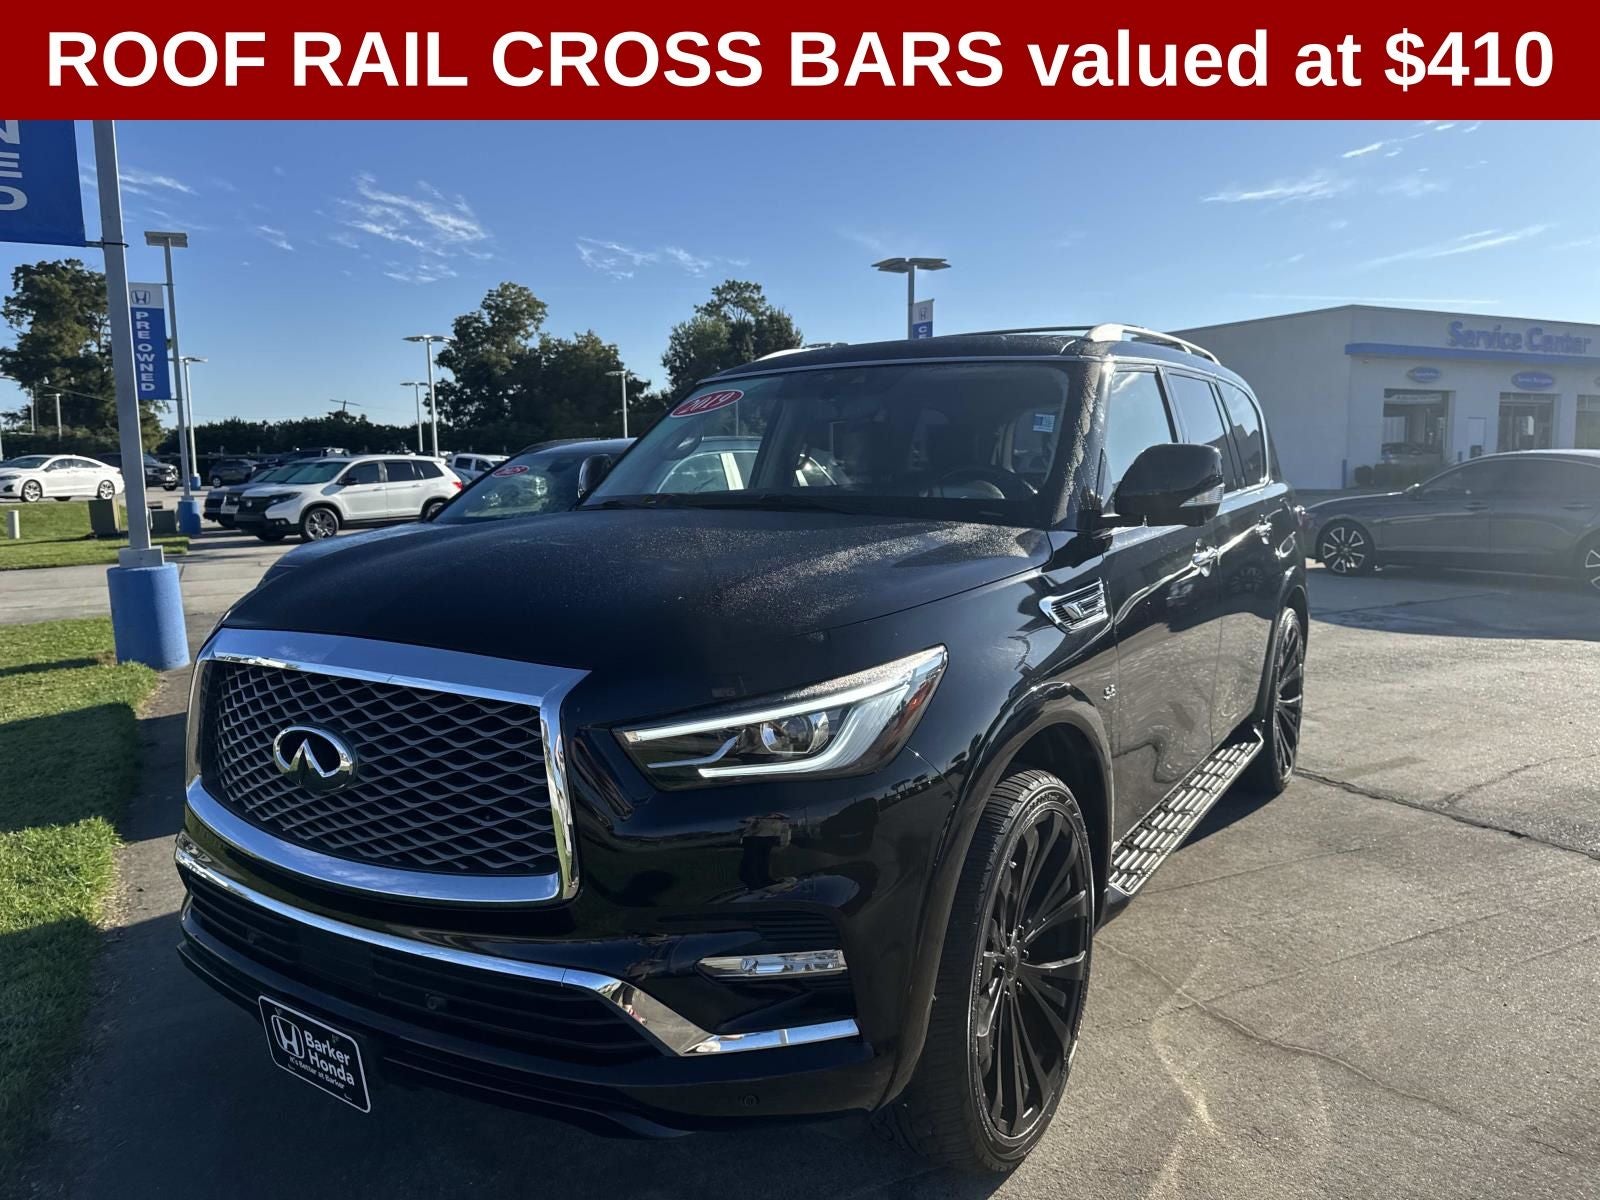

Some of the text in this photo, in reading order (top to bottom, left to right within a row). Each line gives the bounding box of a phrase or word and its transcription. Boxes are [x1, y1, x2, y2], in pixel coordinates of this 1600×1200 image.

[136, 311, 151, 339] PRE
[1447, 320, 1592, 354] Service Center
[136, 343, 156, 391] OWNED
[303, 1030, 350, 1066] Barker
[308, 1049, 355, 1086] Honda
